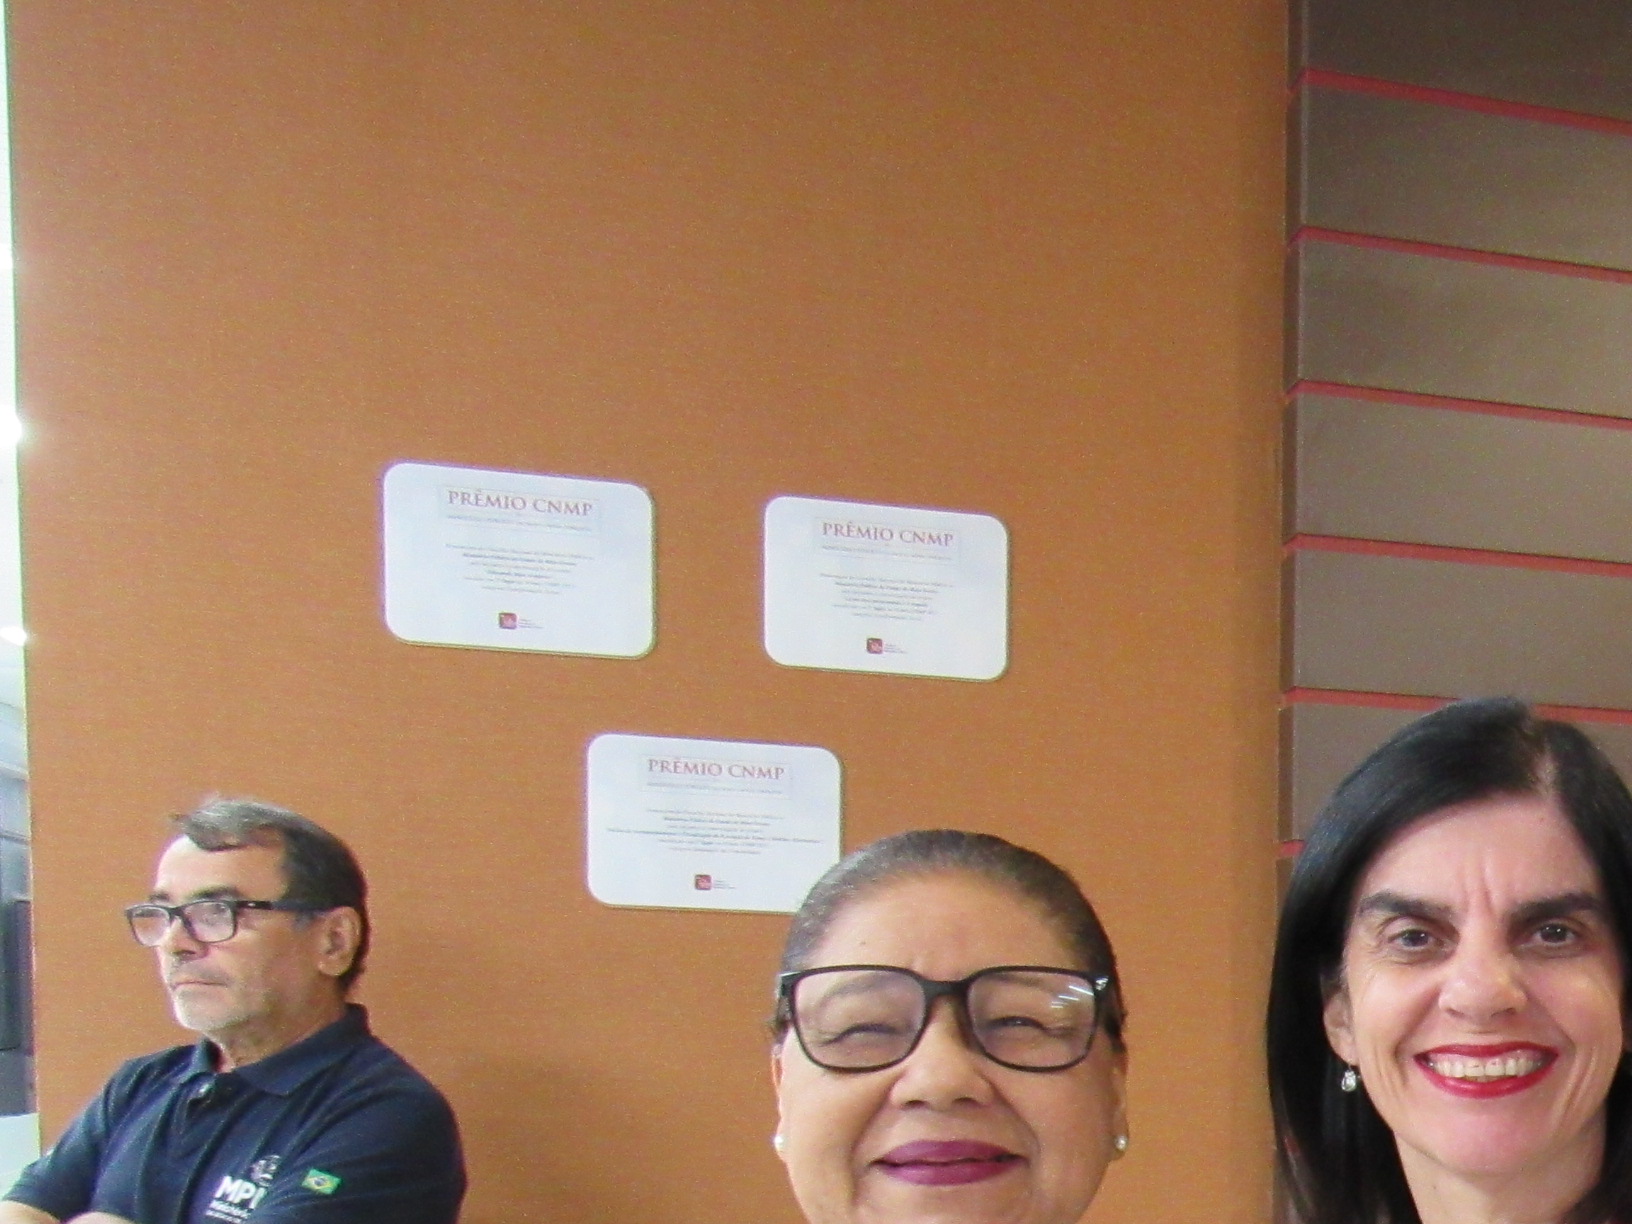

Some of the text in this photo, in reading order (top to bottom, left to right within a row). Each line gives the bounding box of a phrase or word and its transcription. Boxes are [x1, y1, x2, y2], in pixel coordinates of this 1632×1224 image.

[533, 499, 593, 517] CNMP
[900, 530, 954, 547] CNMP
[728, 764, 785, 780] CNMP
